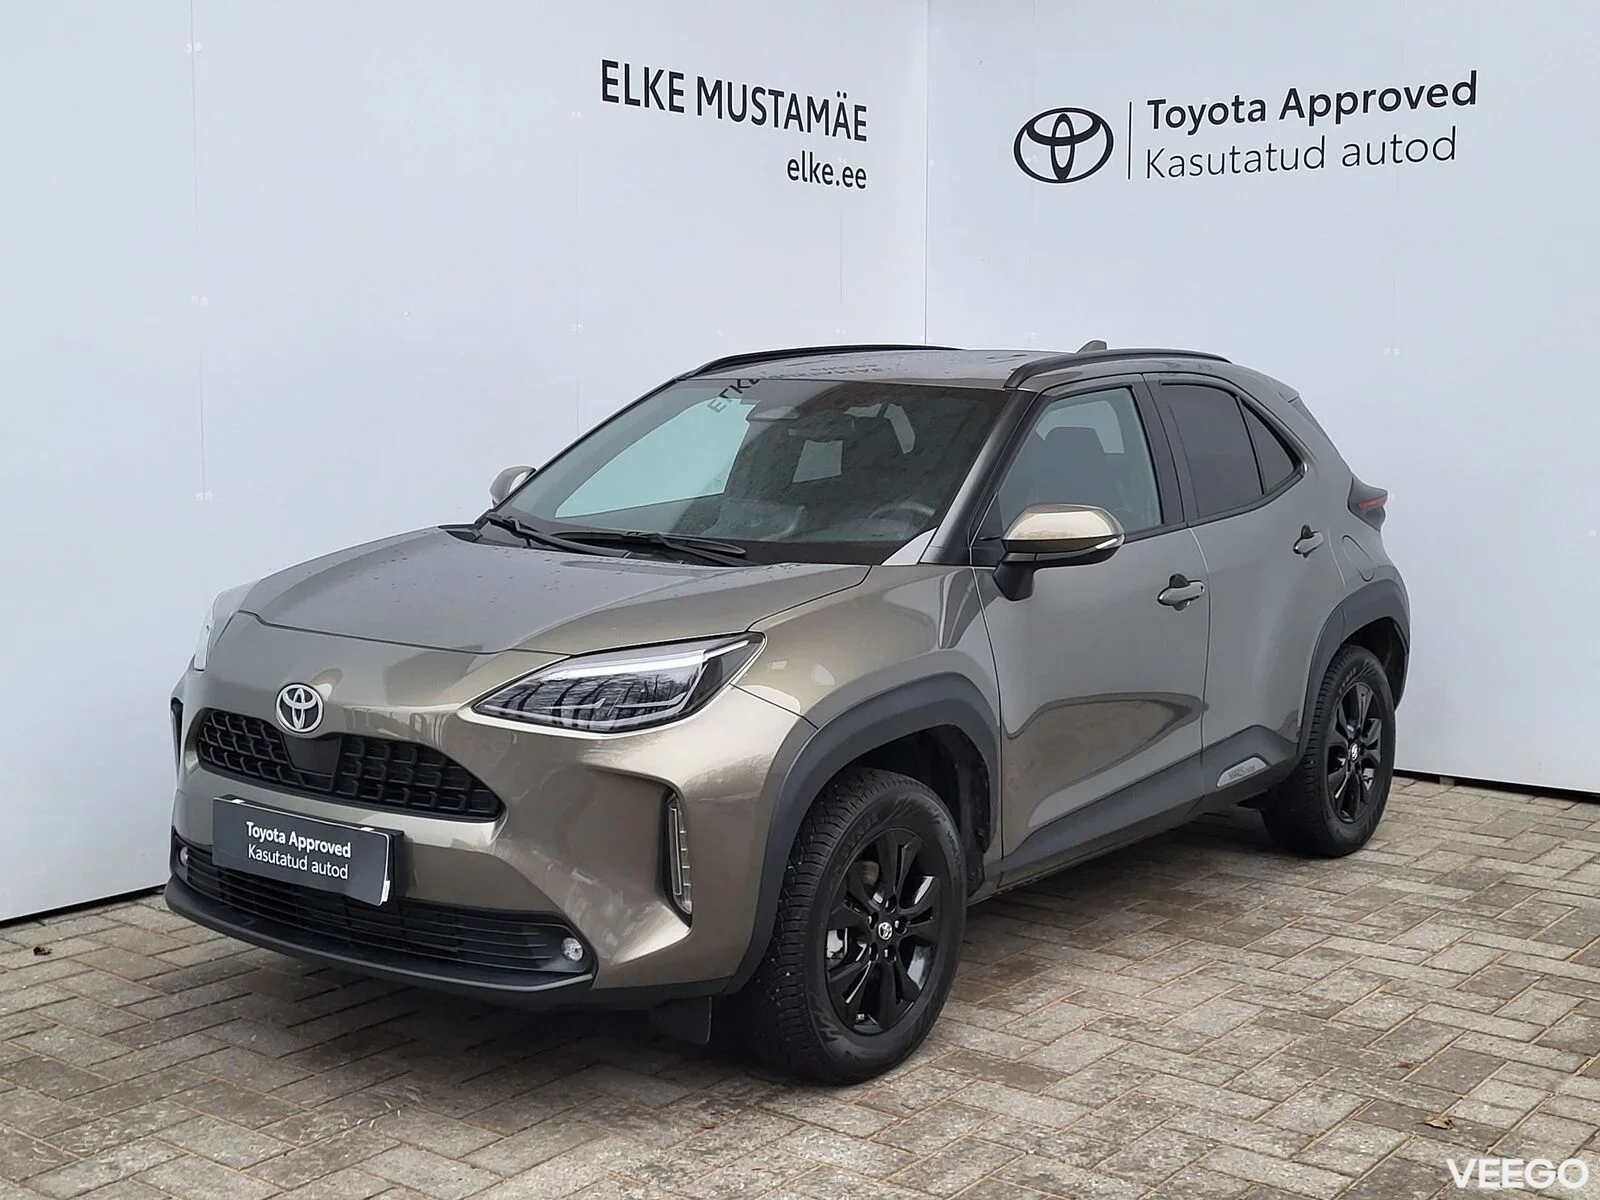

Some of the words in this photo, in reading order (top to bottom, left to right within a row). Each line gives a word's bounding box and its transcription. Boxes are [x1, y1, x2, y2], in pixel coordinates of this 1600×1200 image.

[601, 59, 685, 114] ELKE
[696, 76, 867, 142] MUSTAMÄE
[1147, 95, 1267, 135] Toyota
[1279, 70, 1478, 127] Approved
[786, 150, 867, 190] elke.ee
[1146, 135, 1326, 179] Kasutatud
[1341, 126, 1457, 168] autod
[246, 821, 286, 844] Toyota
[288, 831, 351, 858] Approved
[248, 843, 308, 871] Kasutatud
[311, 860, 349, 880] autod
